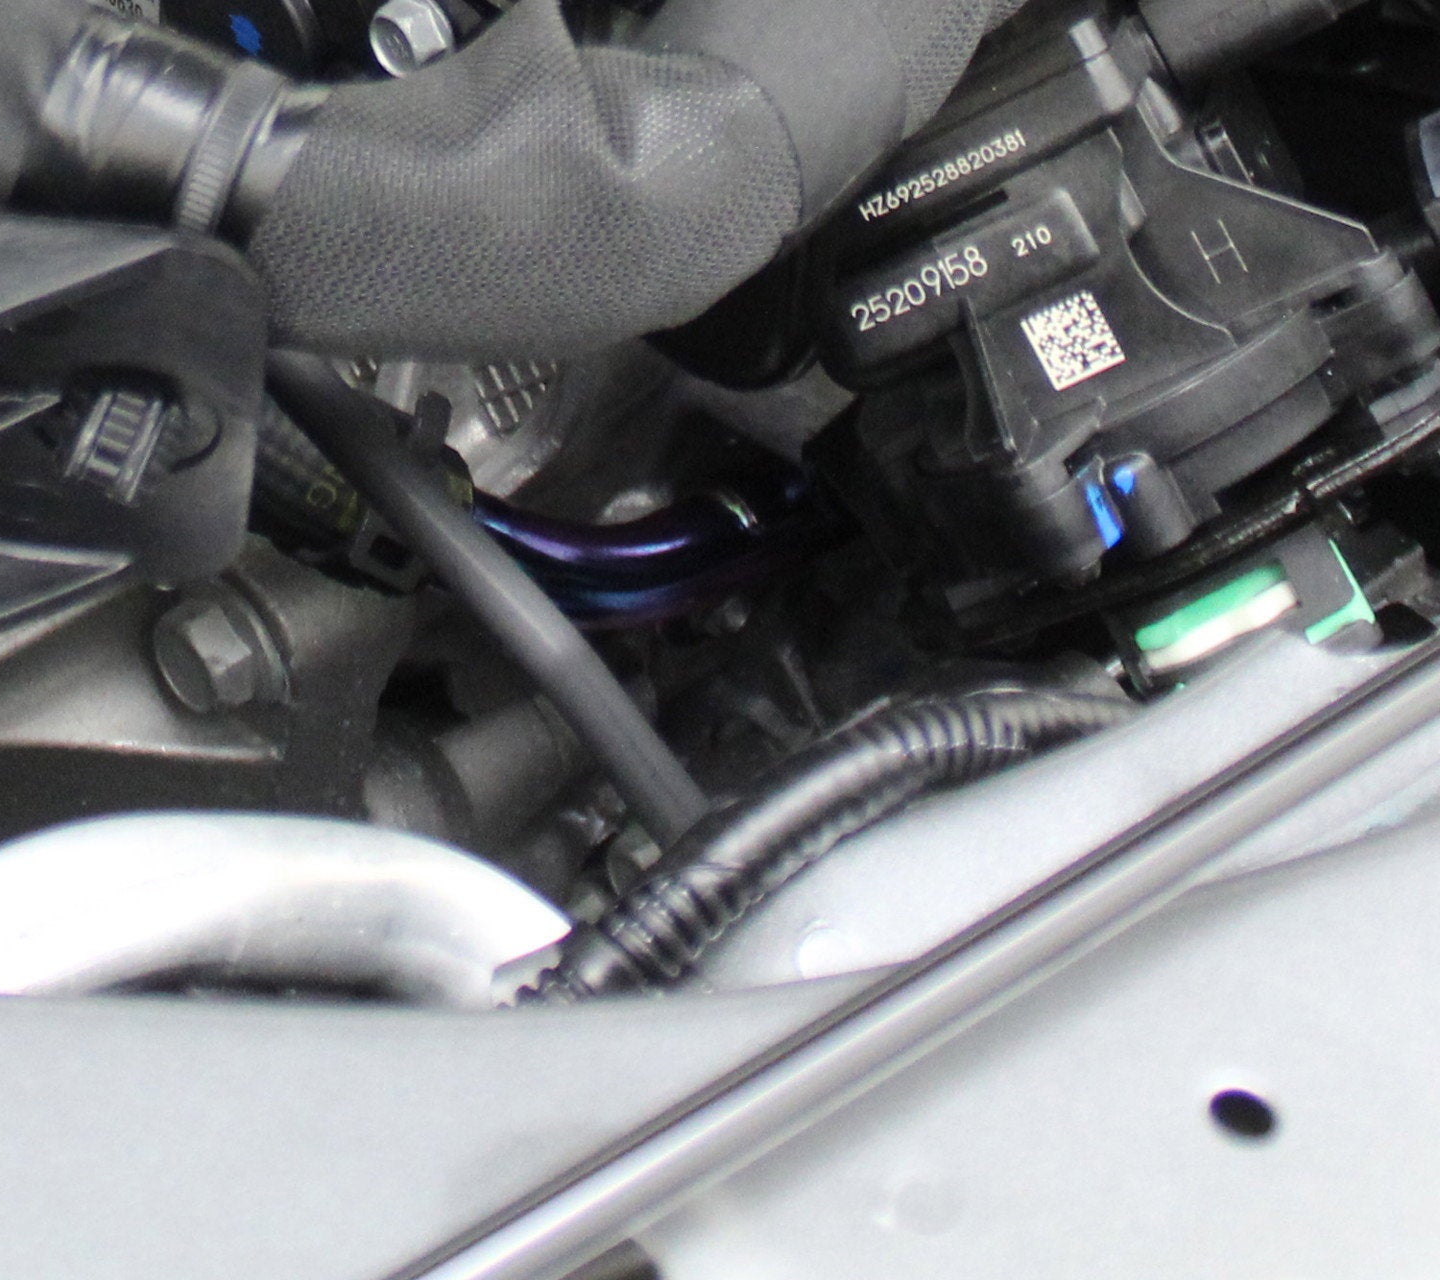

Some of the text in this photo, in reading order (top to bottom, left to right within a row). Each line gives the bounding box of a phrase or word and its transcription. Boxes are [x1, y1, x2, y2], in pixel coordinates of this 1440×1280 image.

[857, 127, 1028, 223] HZ692528820381
[849, 225, 1053, 332] 25209158 210
[1189, 217, 1250, 285] H
